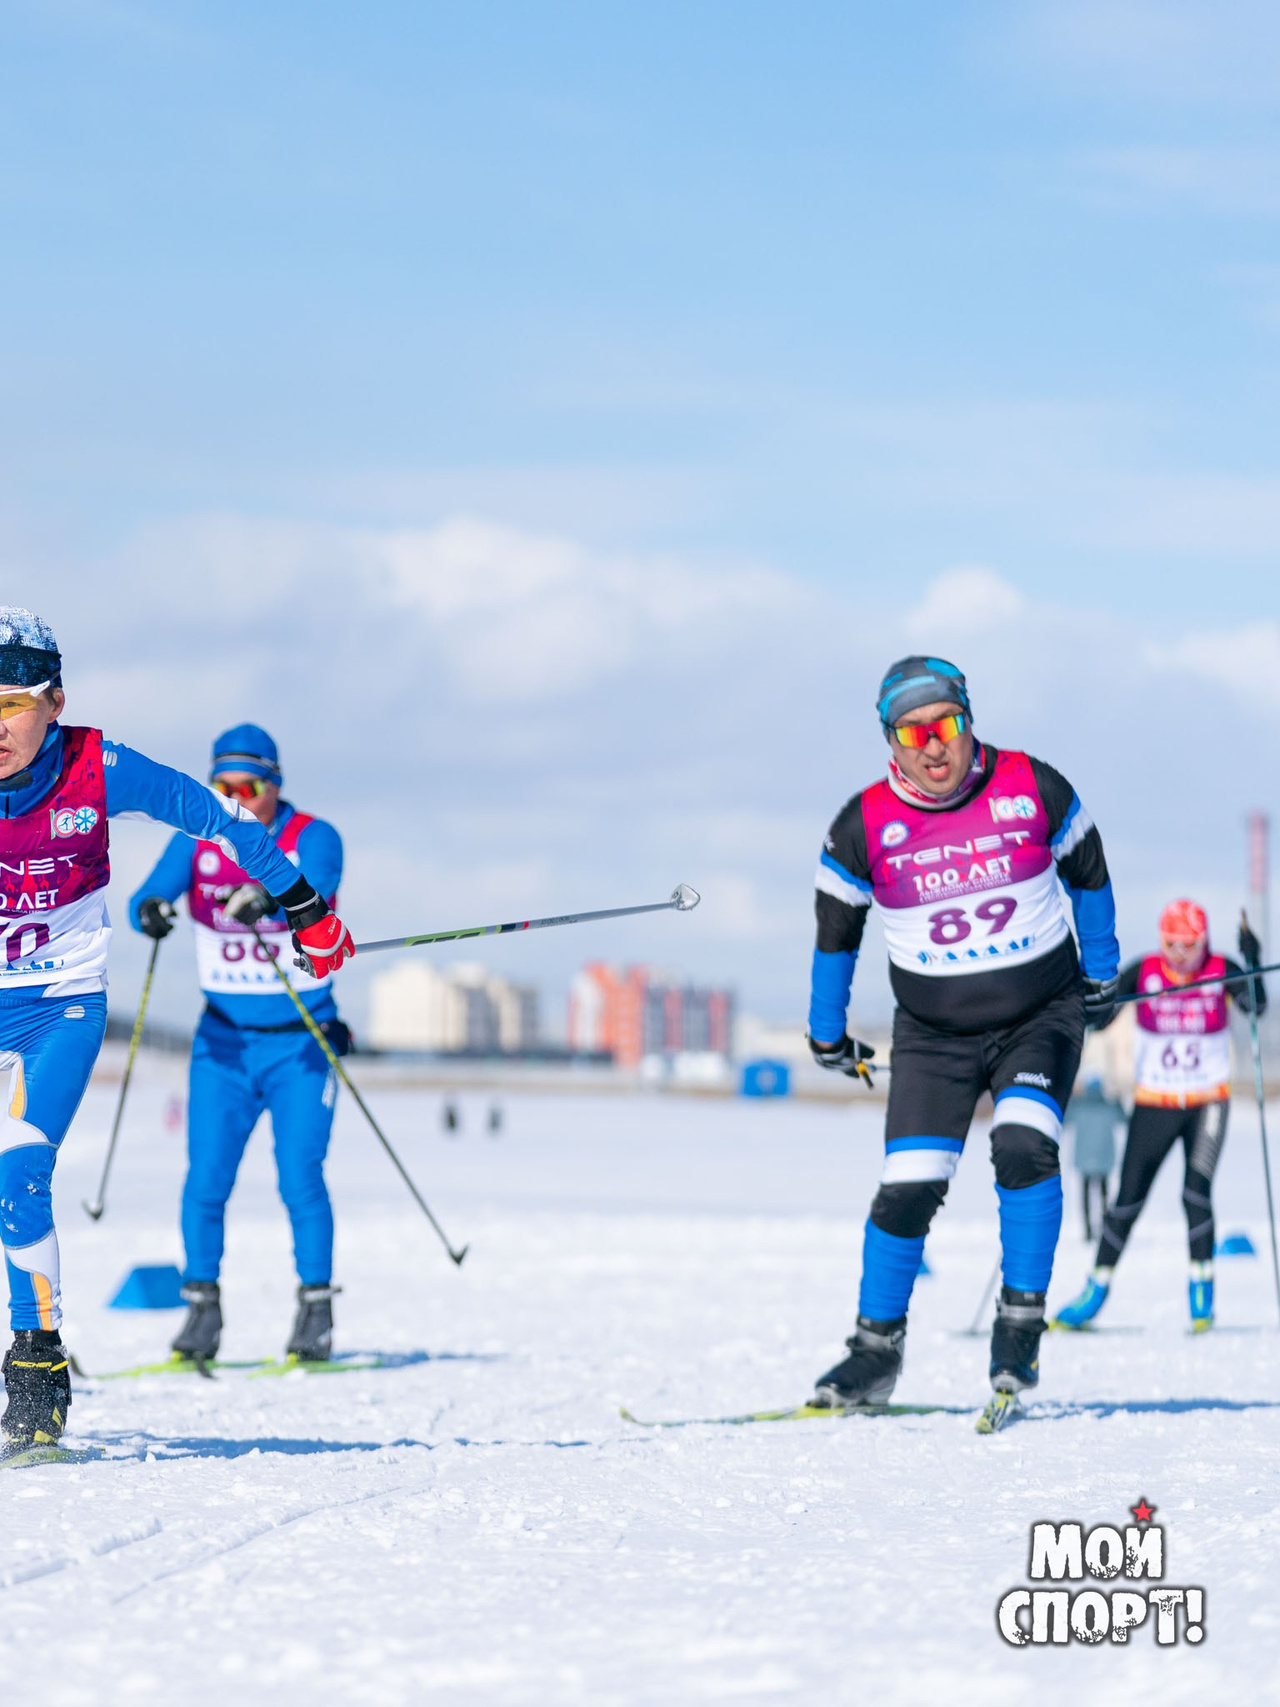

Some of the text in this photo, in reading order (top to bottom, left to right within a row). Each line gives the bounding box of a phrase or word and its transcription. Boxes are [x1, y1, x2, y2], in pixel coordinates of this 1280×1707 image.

[885, 830, 1031, 870] TENET
[913, 855, 1011, 892] 100 ЛЕТ
[16, 888, 59, 909] ЛЕТ
[928, 896, 1018, 945] 89
